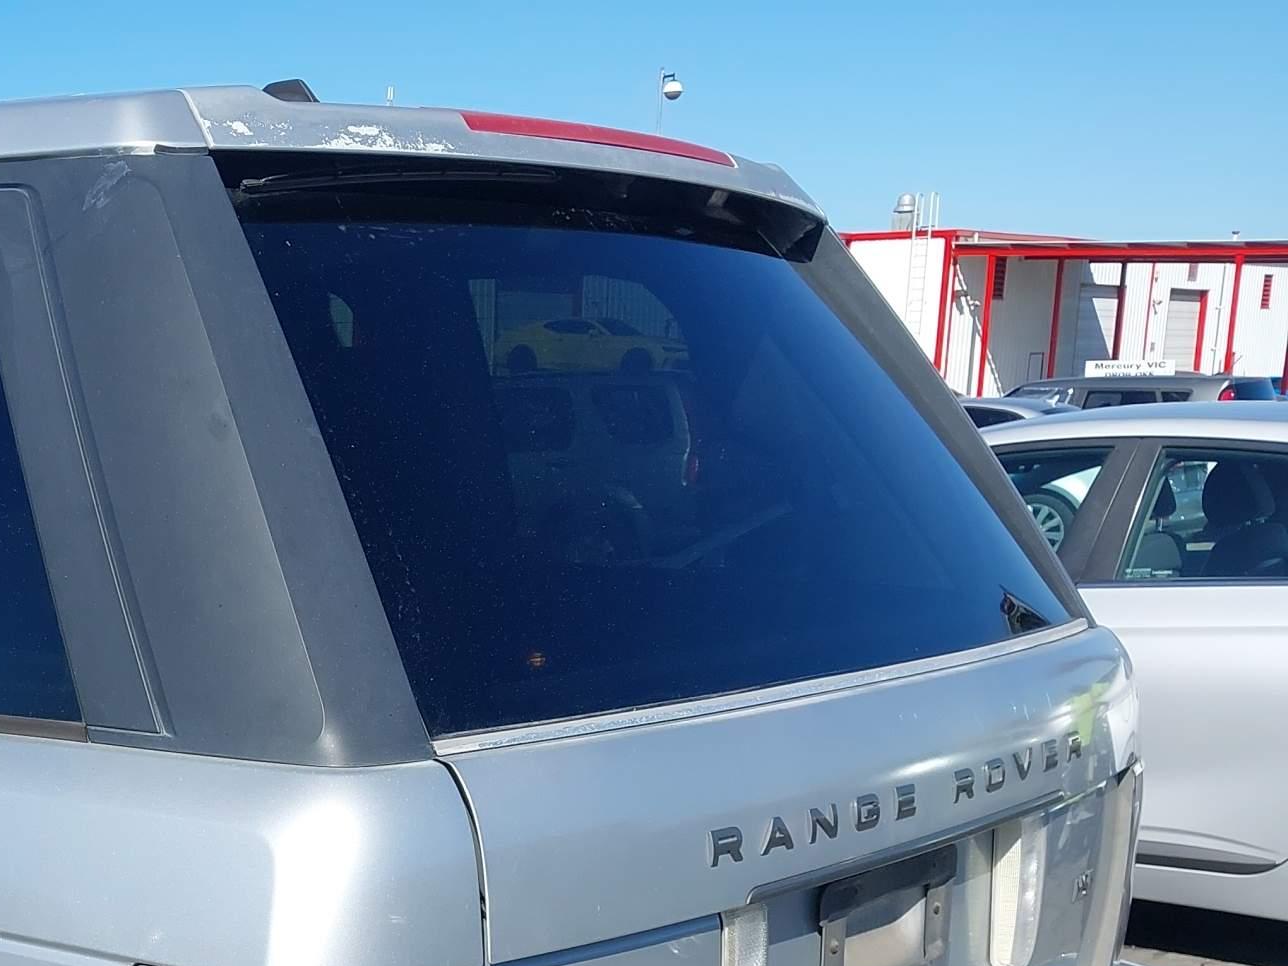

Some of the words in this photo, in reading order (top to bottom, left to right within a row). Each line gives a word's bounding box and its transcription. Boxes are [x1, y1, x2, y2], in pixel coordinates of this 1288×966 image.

[1094, 362, 1142, 370] Mercury
[1147, 361, 1167, 369] VIC
[707, 783, 917, 868] RANGE
[952, 730, 1082, 804] ROVER
